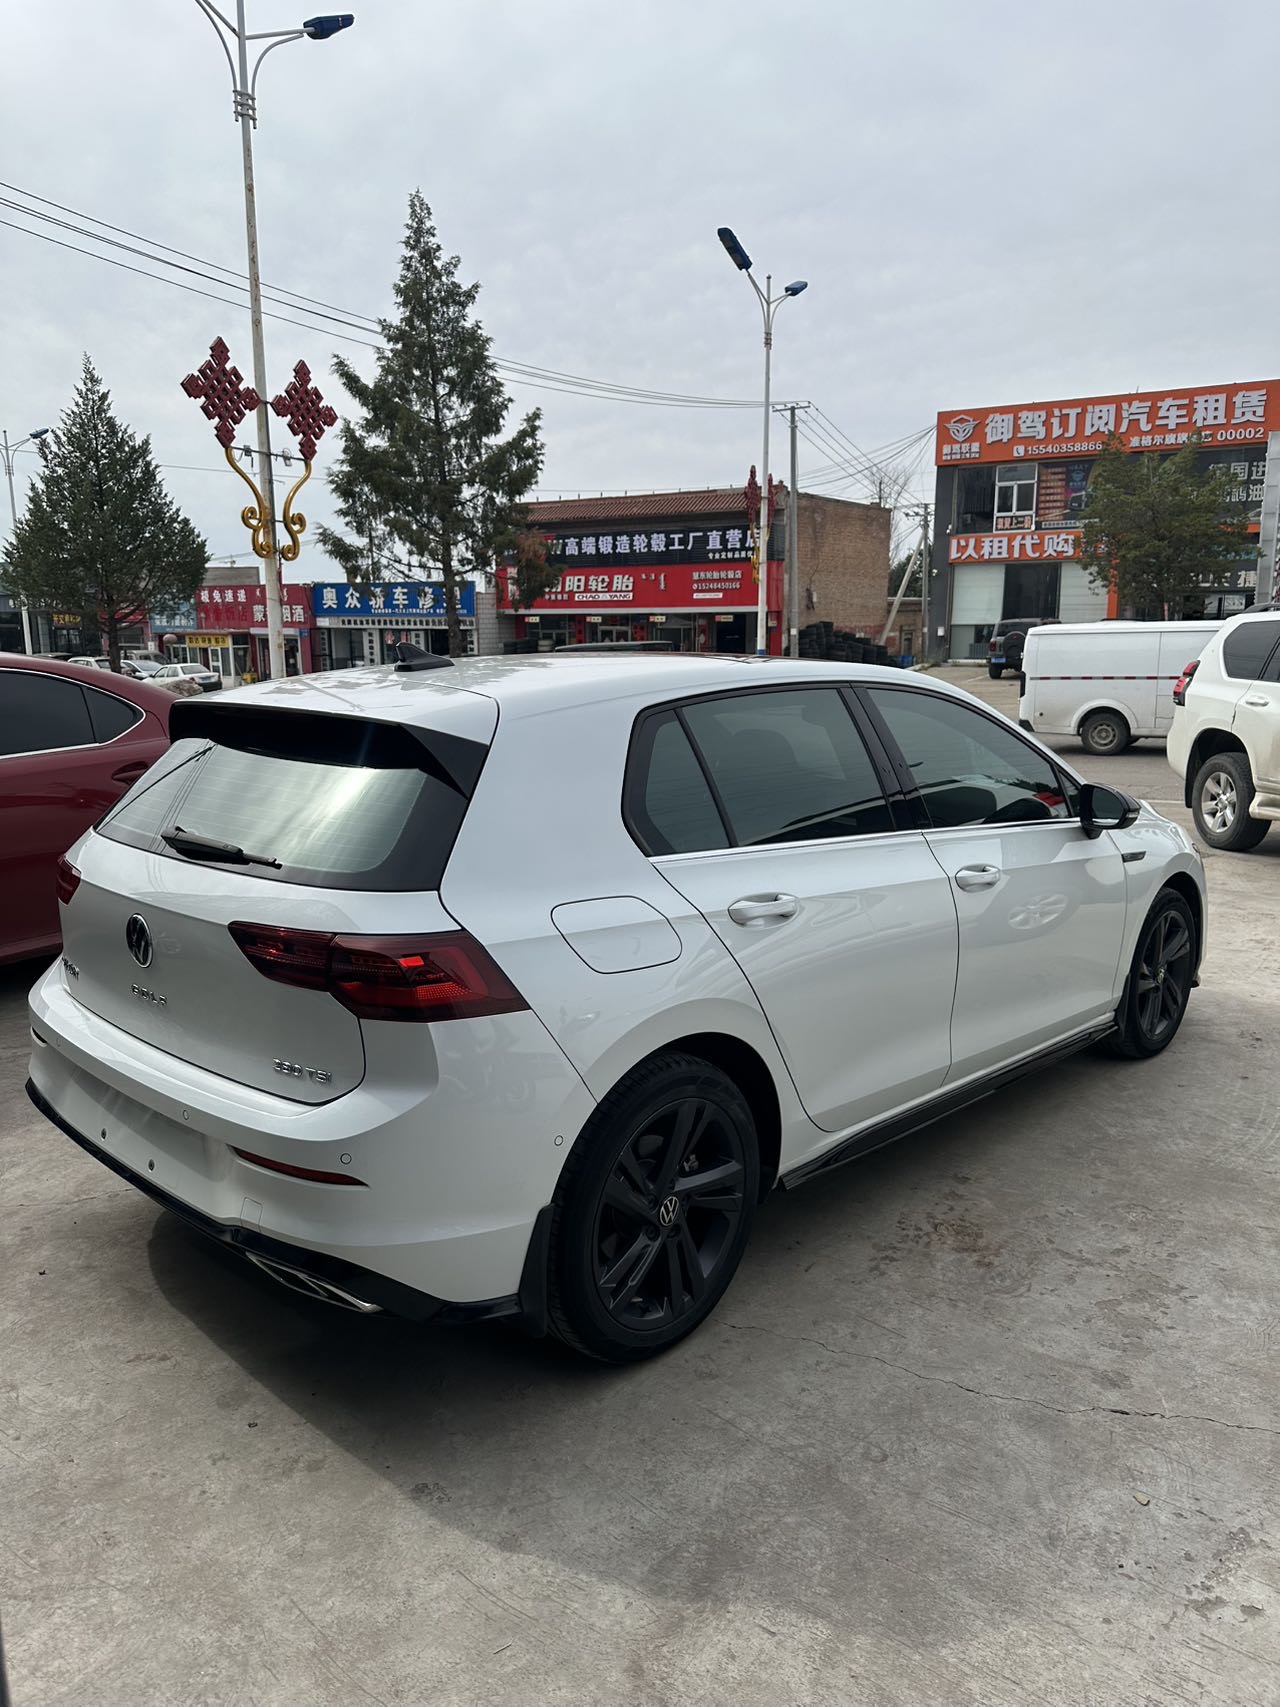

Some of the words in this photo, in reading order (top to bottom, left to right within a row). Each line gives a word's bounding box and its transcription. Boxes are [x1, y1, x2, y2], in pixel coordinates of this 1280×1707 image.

[985, 388, 1268, 444] 御驾订阅汽车租赁
[1217, 427, 1264, 442] 00002
[950, 534, 1075, 560] 以租代购
